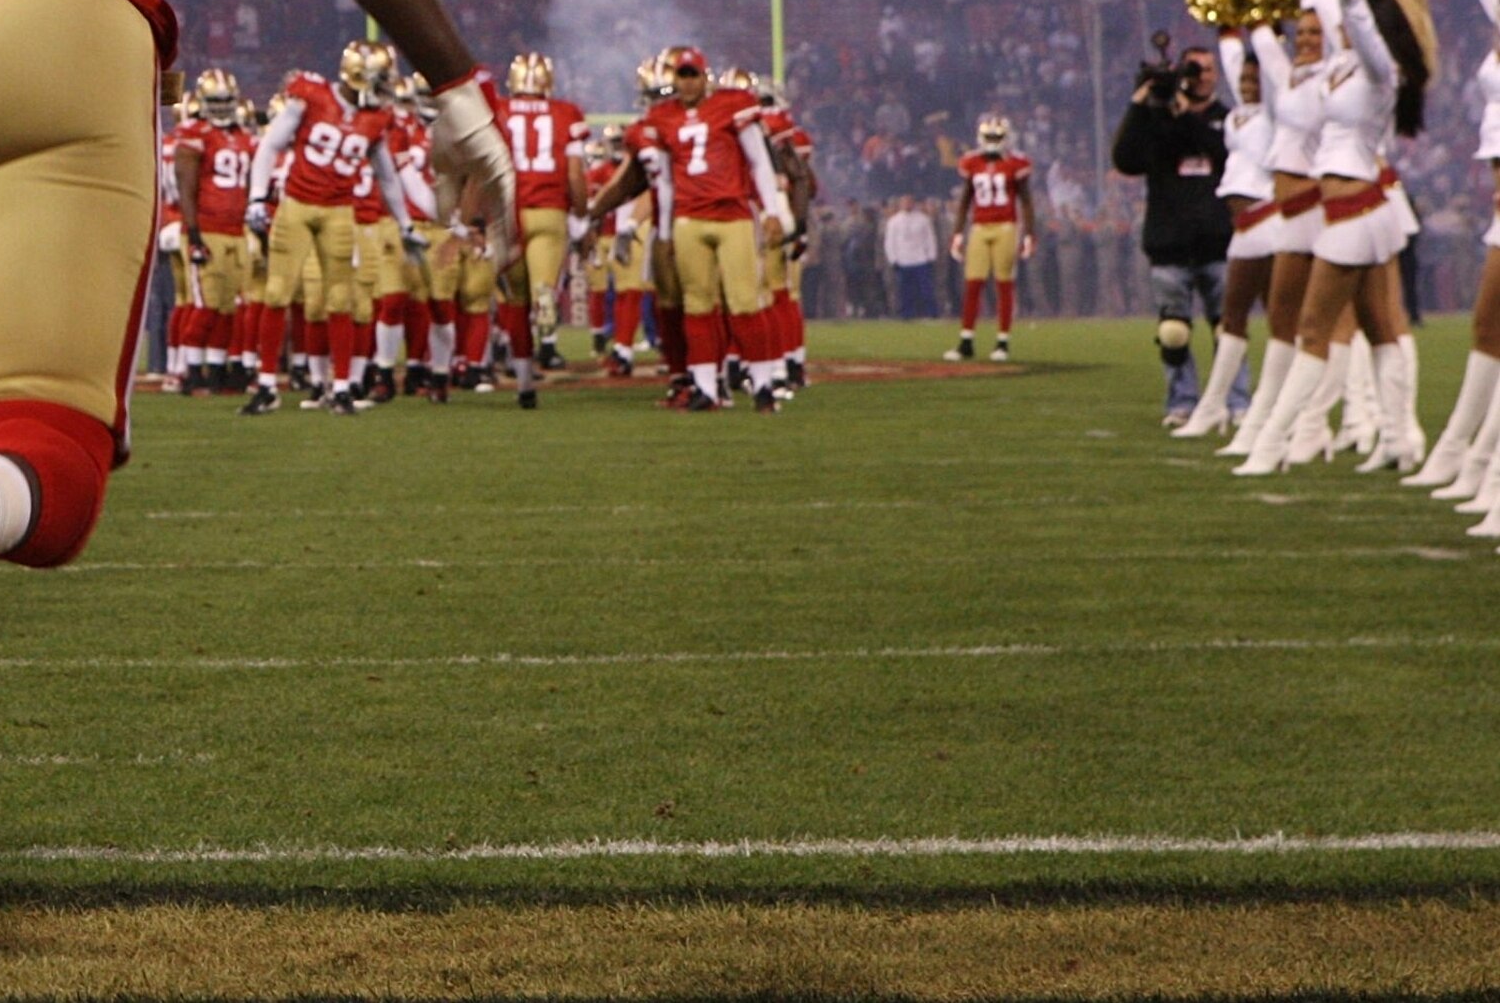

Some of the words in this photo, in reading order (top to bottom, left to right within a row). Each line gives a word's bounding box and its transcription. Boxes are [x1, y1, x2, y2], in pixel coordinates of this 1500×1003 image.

[212, 149, 251, 189] 91
[303, 121, 370, 177] 99
[506, 114, 556, 172] 11
[678, 122, 709, 176] 7
